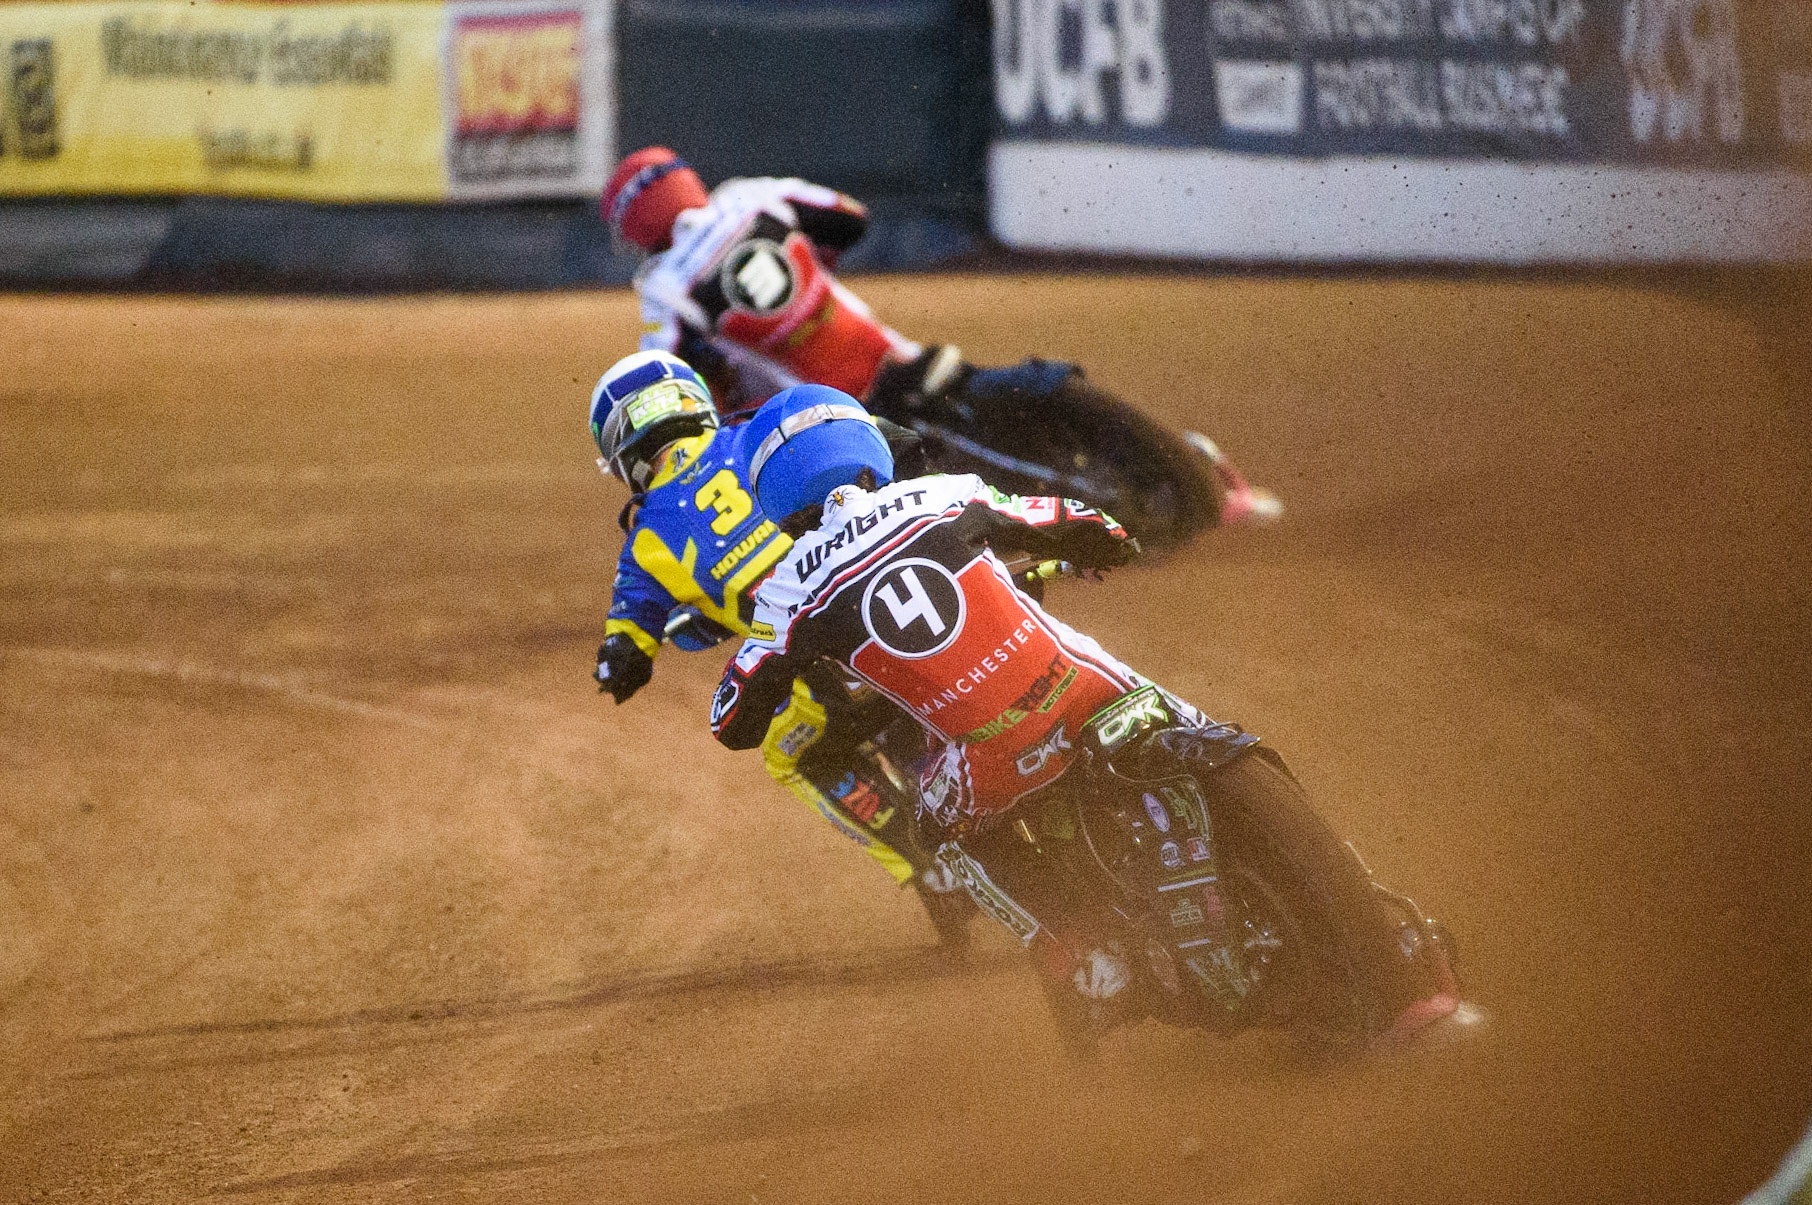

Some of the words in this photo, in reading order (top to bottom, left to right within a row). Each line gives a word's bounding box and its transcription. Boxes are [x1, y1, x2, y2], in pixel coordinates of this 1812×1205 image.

[694, 469, 753, 536] 3
[795, 490, 927, 584] WRIGHT
[874, 567, 947, 637] 4
[917, 619, 1037, 717] MANCHESTER
